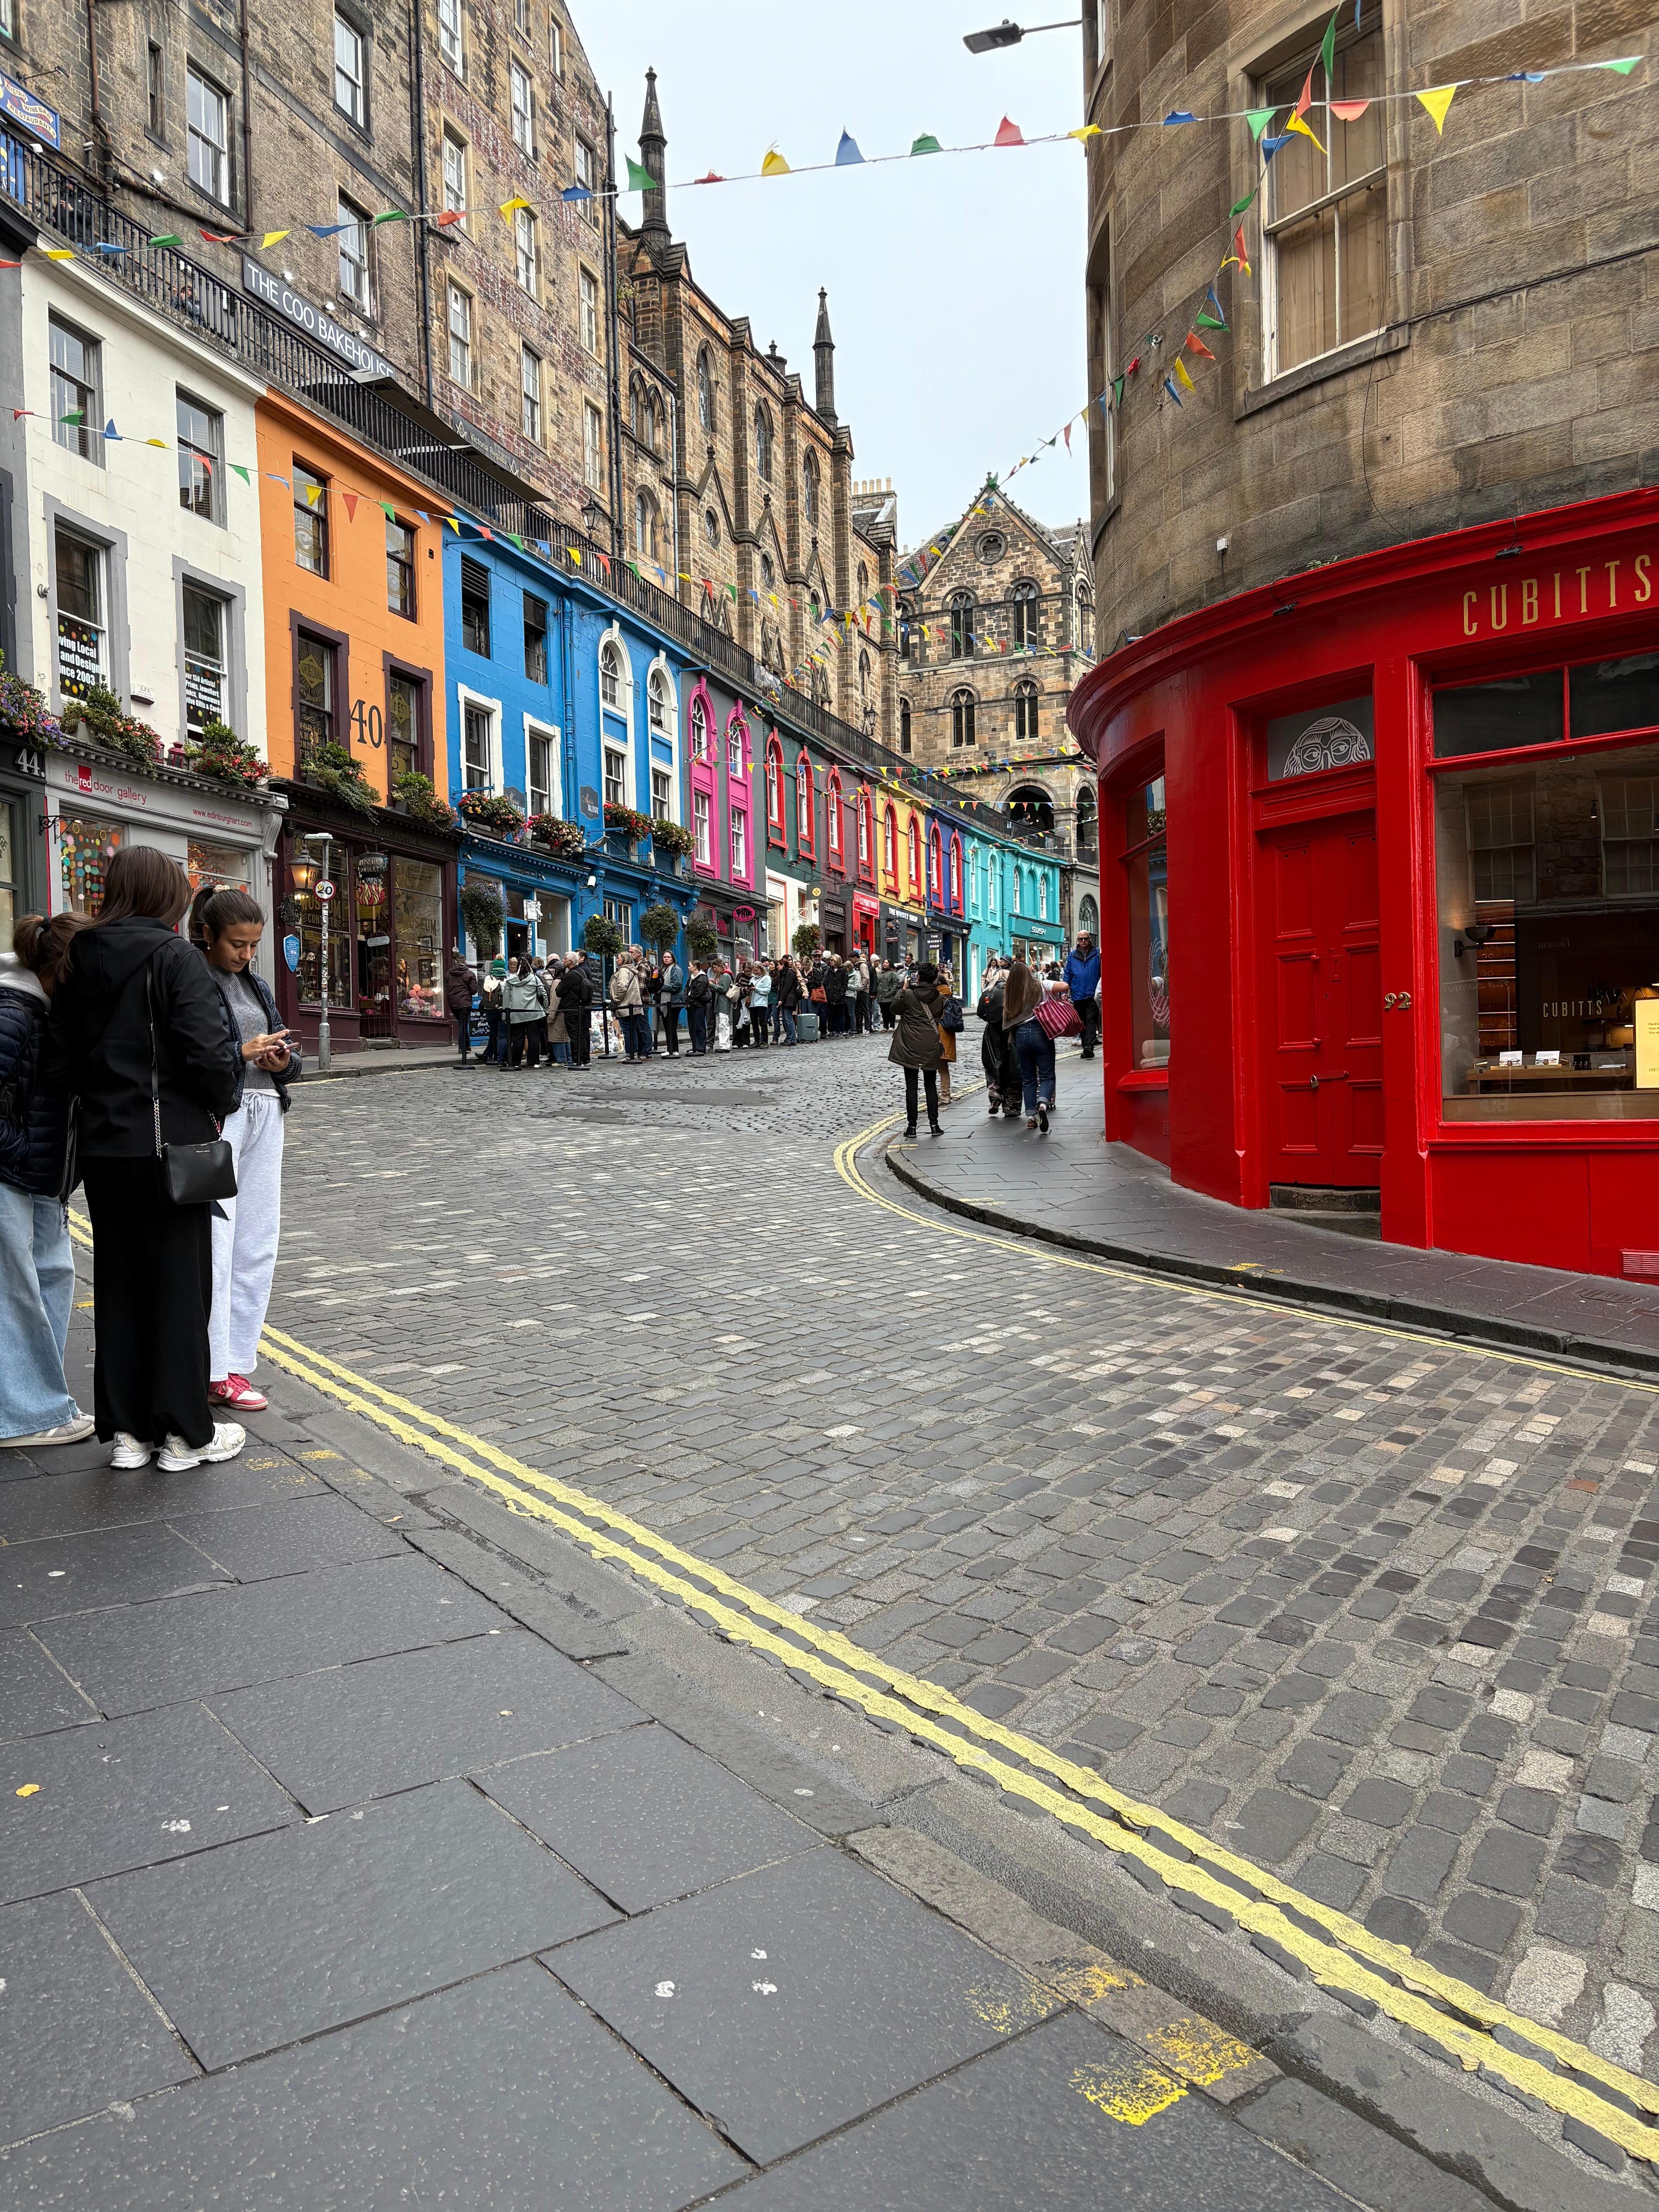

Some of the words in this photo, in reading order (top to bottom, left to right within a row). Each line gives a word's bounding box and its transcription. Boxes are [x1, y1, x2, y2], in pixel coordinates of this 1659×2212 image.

[10, 105, 51, 132] RESTAURANT
[247, 263, 279, 305] THE
[283, 291, 314, 329] COO
[319, 316, 394, 377] BAKEHOUSE
[469, 432, 488, 452] Victoria
[489, 446, 507, 465] Regalia
[1463, 555, 1651, 635] CUBITTS
[77, 641, 96, 659] Local
[60, 651, 75, 665] and
[75, 654, 101, 674] Design
[76, 669, 95, 686] 2003
[196, 699, 206, 709] Gifts
[210, 704, 222, 714] Cards
[198, 692, 220, 706] Homeware
[394, 701, 407, 715] BEST
[351, 699, 383, 748] 40
[65, 770, 78, 785] the
[79, 776, 92, 788] red
[94, 778, 113, 794] door
[118, 787, 147, 805] gallery
[588, 804, 599, 814] BLEUE
[193, 809, 252, 828] www.edinburghart.com
[309, 871, 316, 881] 40
[317, 884, 333, 895] 20
[909, 914, 918, 922] SHOP
[1030, 926, 1046, 935] SWISH
[1384, 992, 1412, 1009] 92
[1543, 1000, 1602, 1018] CUBITTS
